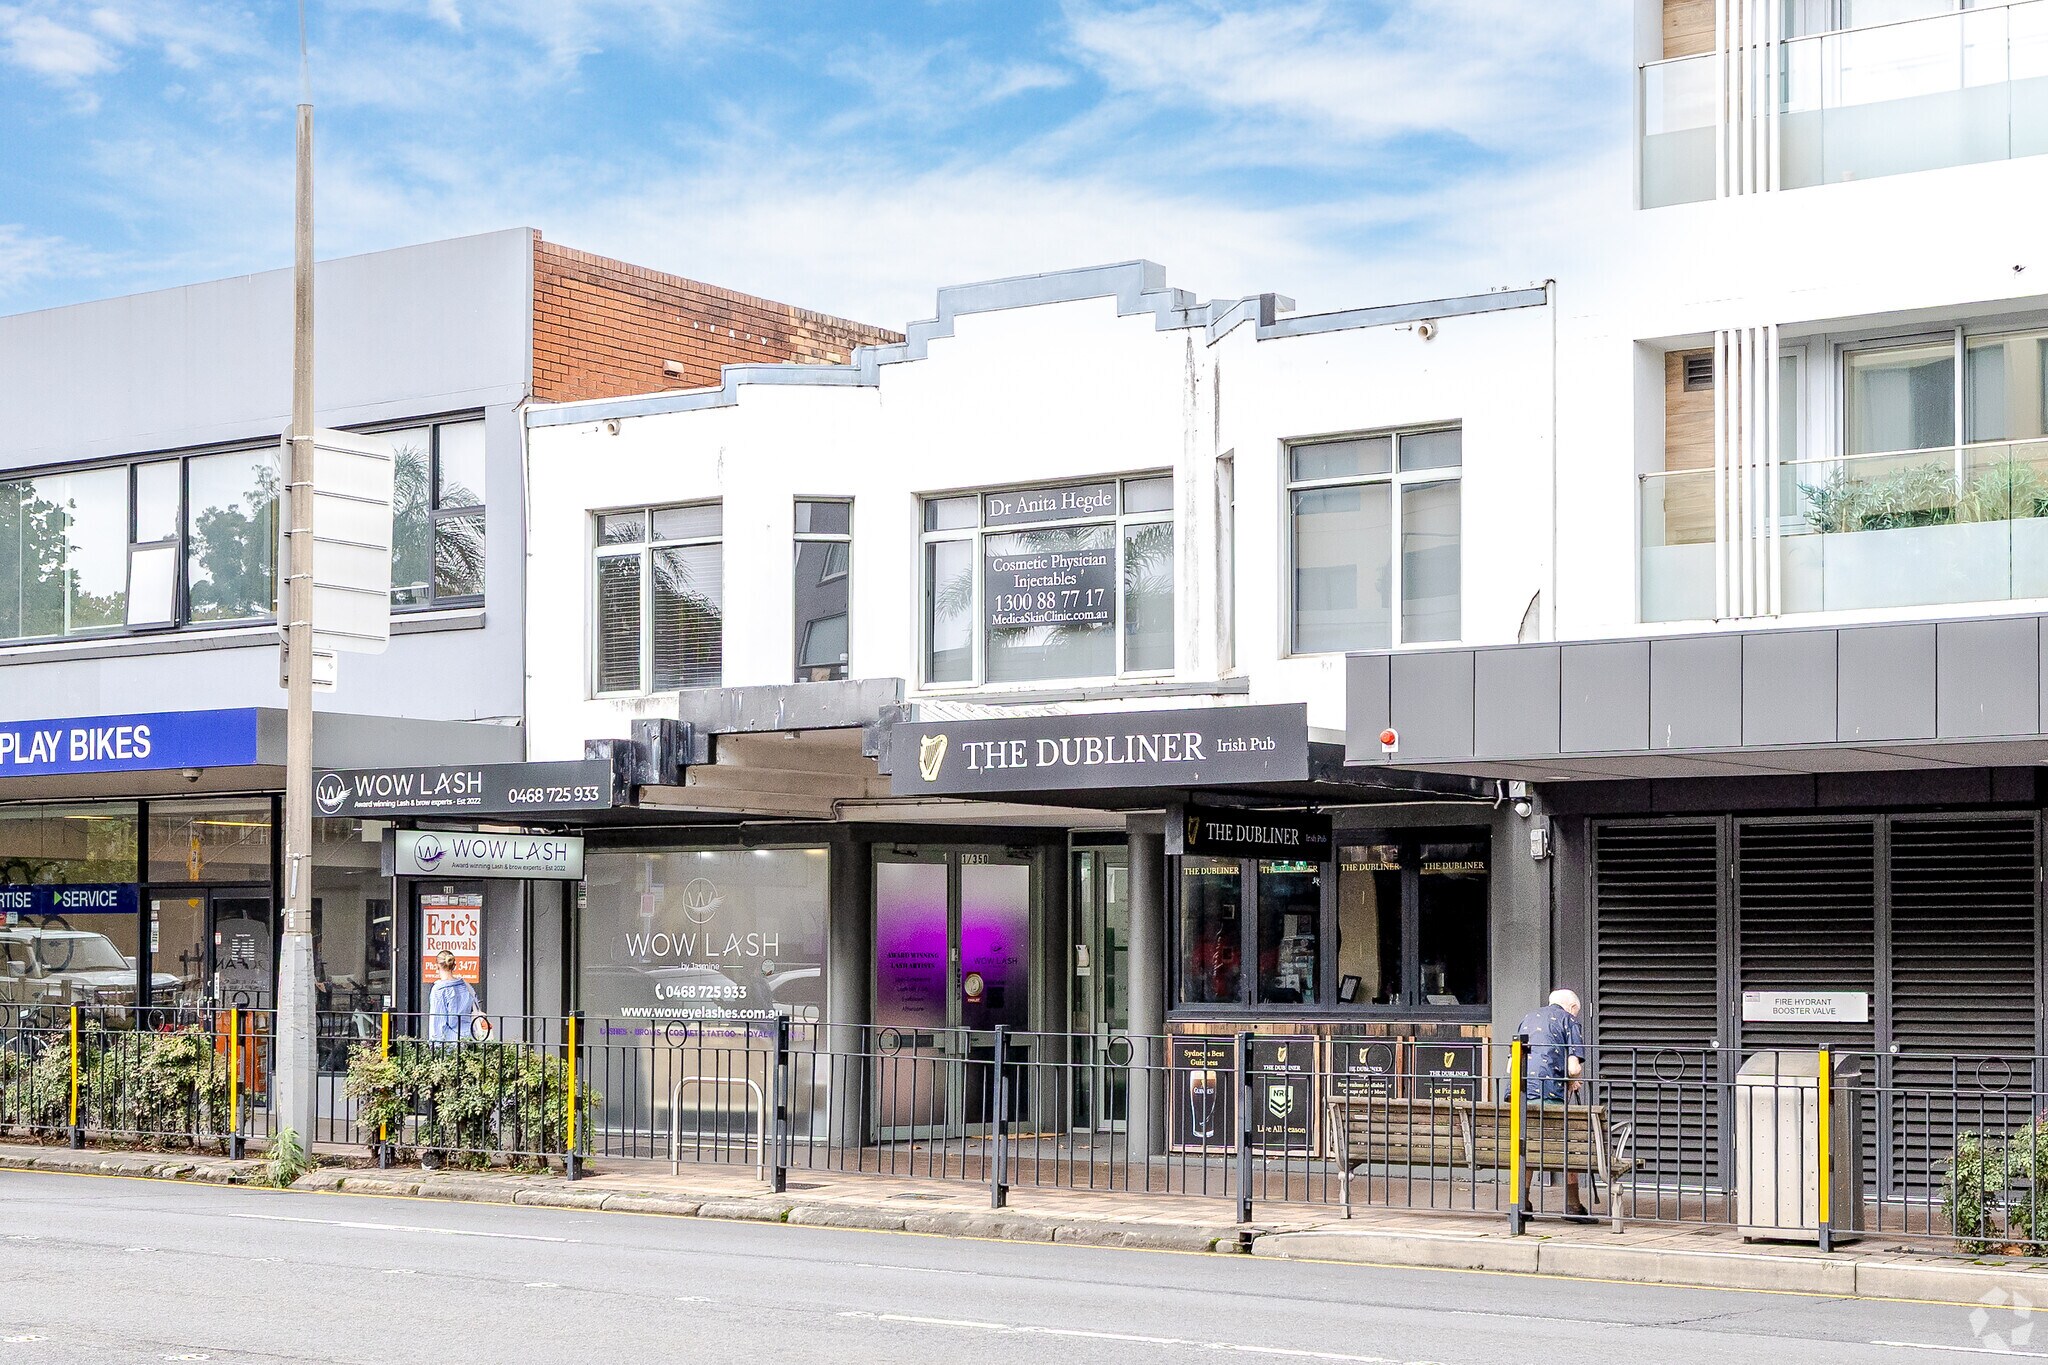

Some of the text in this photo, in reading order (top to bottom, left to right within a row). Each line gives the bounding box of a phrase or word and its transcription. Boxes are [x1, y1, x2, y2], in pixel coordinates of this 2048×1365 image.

[990, 489, 1112, 517] Dr Anita Hegde
[992, 552, 1107, 572] Cosmetic Physician
[1014, 572, 1077, 591] Injectables
[994, 588, 1105, 612] 1300 88 77 17
[992, 610, 1108, 625] MedicaSkinClinic.com.au
[0, 725, 151, 764] PLAY BIKES
[962, 732, 1276, 771] THE DUBLINER Irish Pub
[354, 772, 482, 796] WOW LASH
[508, 786, 599, 804] 0468 725 933
[354, 800, 372, 808] Award
[373, 800, 396, 808] winning
[396, 799, 410, 807] Lash
[416, 798, 430, 806] brow
[431, 798, 452, 808] experts
[466, 797, 482, 805] 2022
[1206, 822, 1233, 840] THE
[1236, 824, 1300, 845] DUBLINER
[452, 838, 567, 861] WOW LASH
[962, 854, 988, 864] 1/350
[1424, 862, 1484, 870] THE DUBLINER
[470, 862, 490, 870] winning
[522, 864, 542, 872] experts
[554, 864, 566, 872] 2022
[1184, 866, 1240, 875] THE DUBLINER
[1359, 863, 1400, 871] DUBLINER
[62, 890, 118, 908] SERVICE
[426, 914, 478, 936] Eric's
[427, 938, 476, 951] Removals
[626, 933, 780, 957] WOW LASH
[458, 960, 477, 971] 3477
[974, 956, 1018, 964] WOW LASH
[666, 985, 747, 999] 0468 725 933
[1775, 998, 1832, 1006] FIRE HYDRANT
[621, 1006, 783, 1020] www.woweyelashes.com.au
[1772, 1007, 1810, 1015] BOOSTER
[668, 1029, 706, 1037] COSMETC
[706, 1030, 736, 1038] TATTOO
[1184, 1050, 1210, 1058] Sydneys
[1258, 1124, 1272, 1133] Lie
[1284, 1126, 1306, 1134] eason
